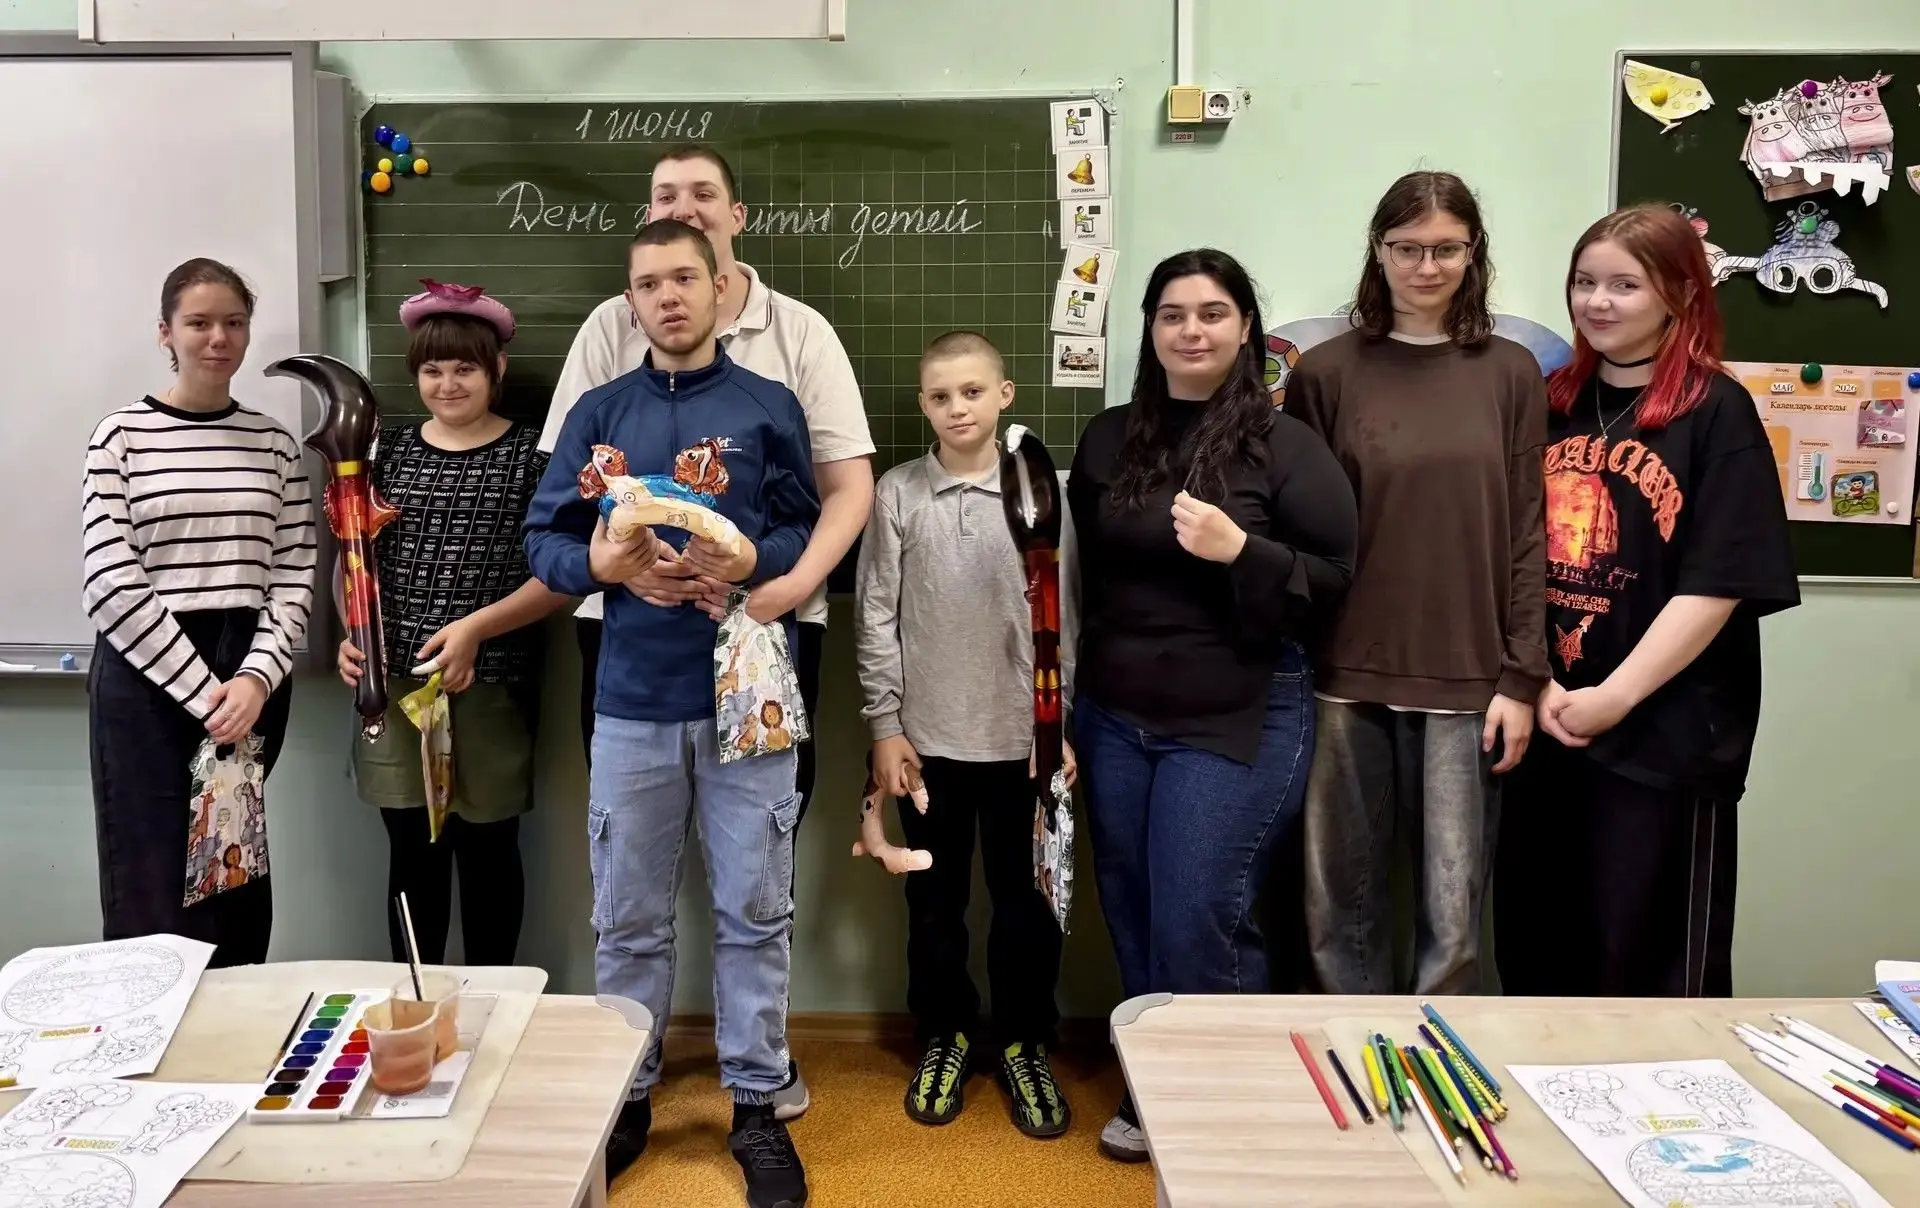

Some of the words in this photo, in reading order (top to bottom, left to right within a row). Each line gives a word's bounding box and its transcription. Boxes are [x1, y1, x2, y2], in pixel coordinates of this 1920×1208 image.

[575, 108, 593, 140] 1
[495, 181, 617, 233] День
[838, 198, 983, 270] детей
[1773, 383, 1793, 392] МАЙ
[1770, 400, 1813, 411] Календарь
[418, 569, 427, 577] HI
